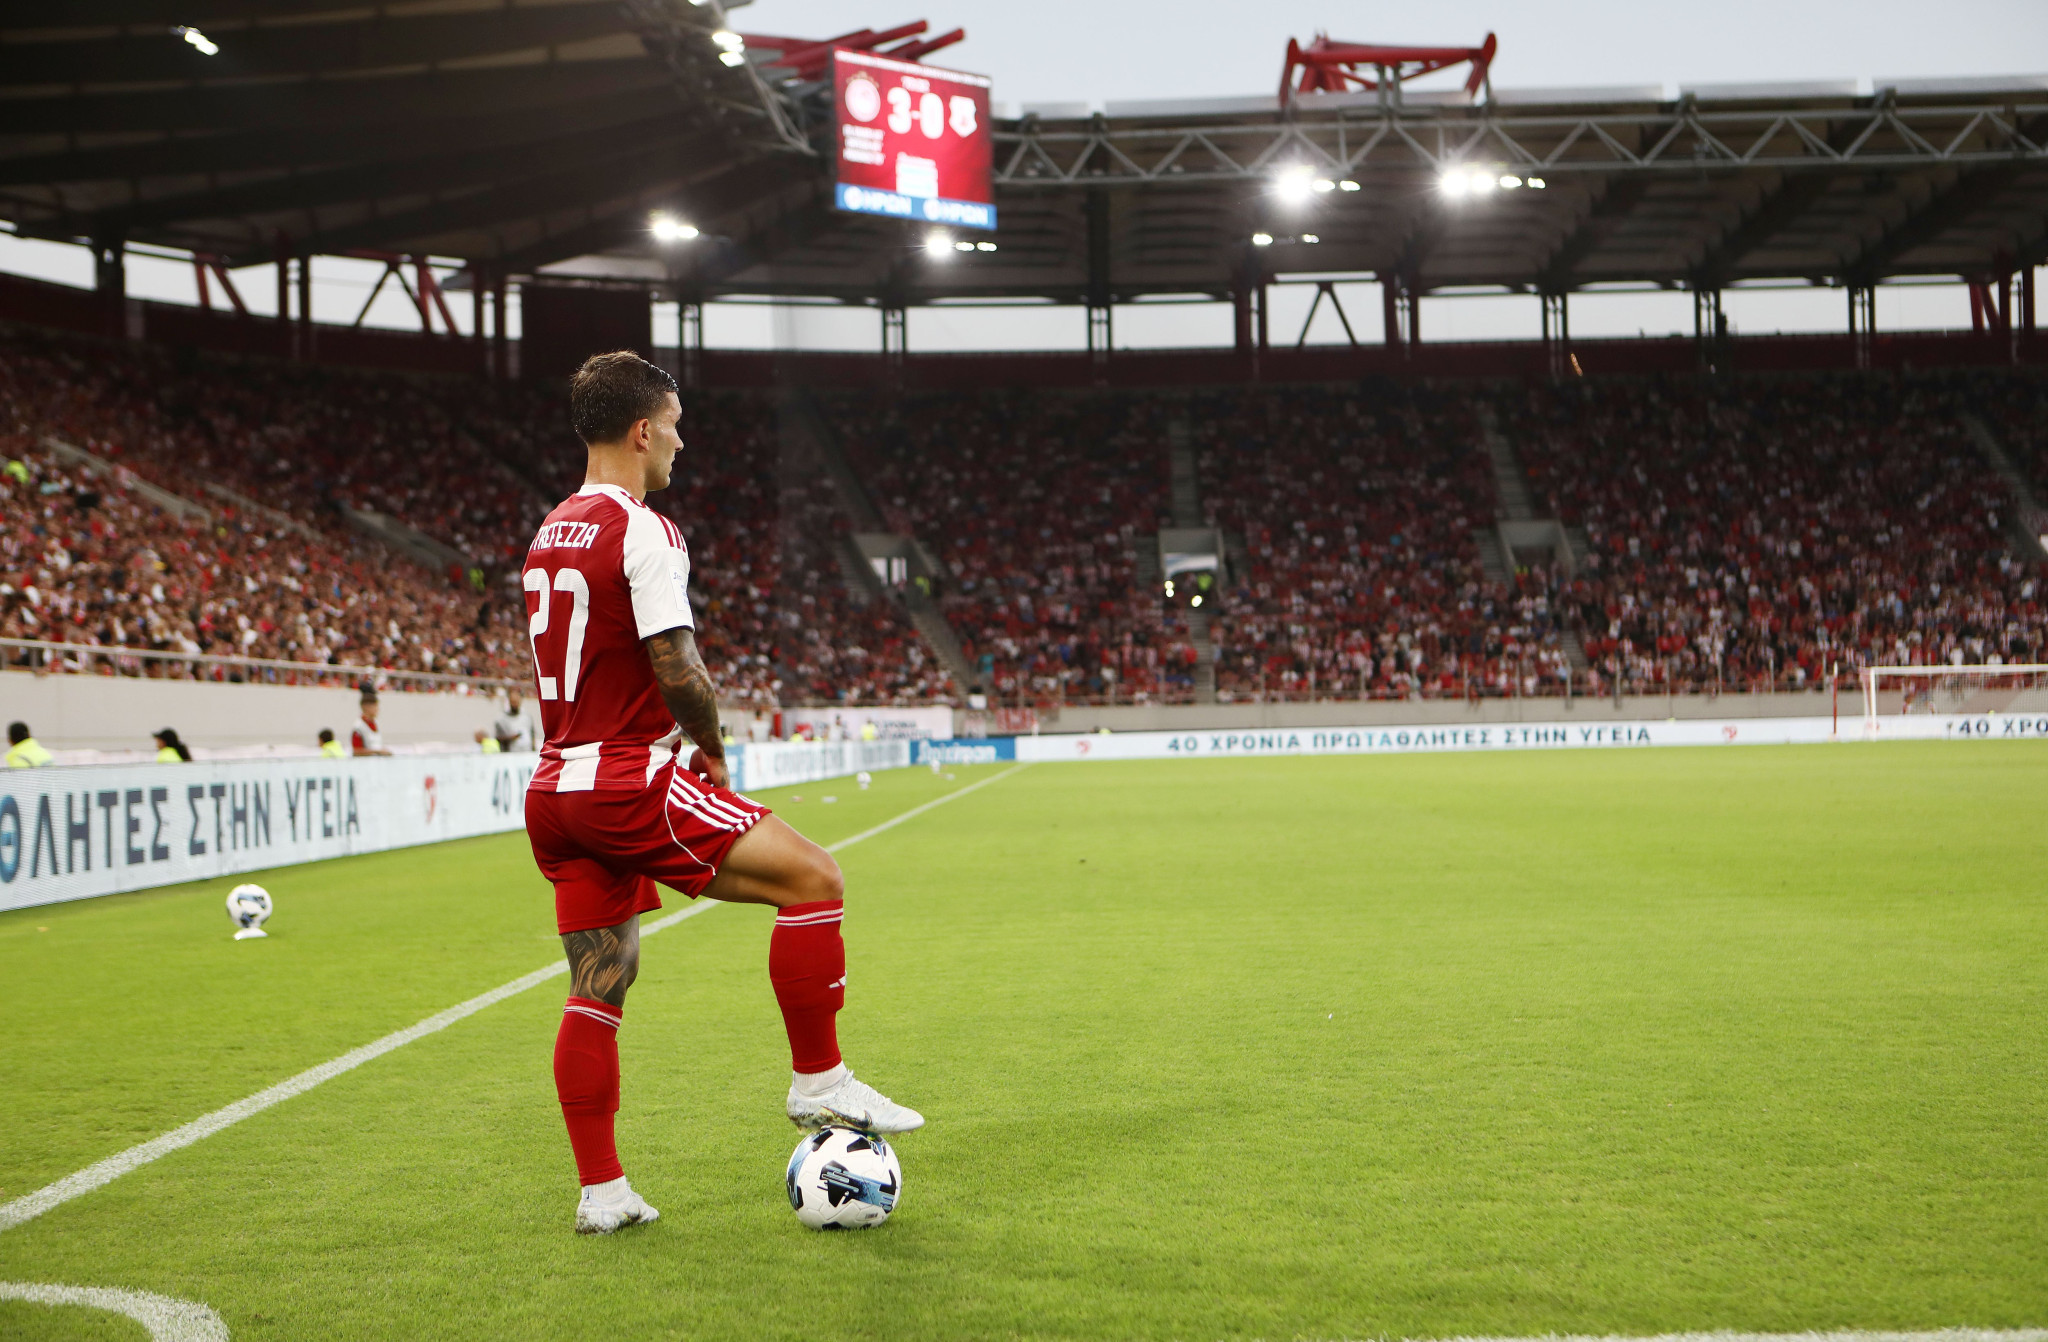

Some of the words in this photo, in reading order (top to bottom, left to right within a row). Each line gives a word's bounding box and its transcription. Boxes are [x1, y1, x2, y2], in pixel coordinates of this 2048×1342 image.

[528, 521, 600, 551] TREFEZZA
[523, 568, 589, 702] 27
[1168, 736, 1198, 751] 40
[1211, 734, 1300, 750] ΧΡΟΝΙΑ
[1313, 729, 1491, 748] ΠΡΩΤΑΘΛΗΤΕΣ
[1504, 728, 1567, 743] ΣΤΗΝ
[1580, 726, 1651, 742] ΥΓΕΙΑ
[1959, 720, 1990, 735] 40
[188, 780, 271, 856] ΣΤΗΝ
[285, 776, 361, 842] ΥΓΕΙΑ
